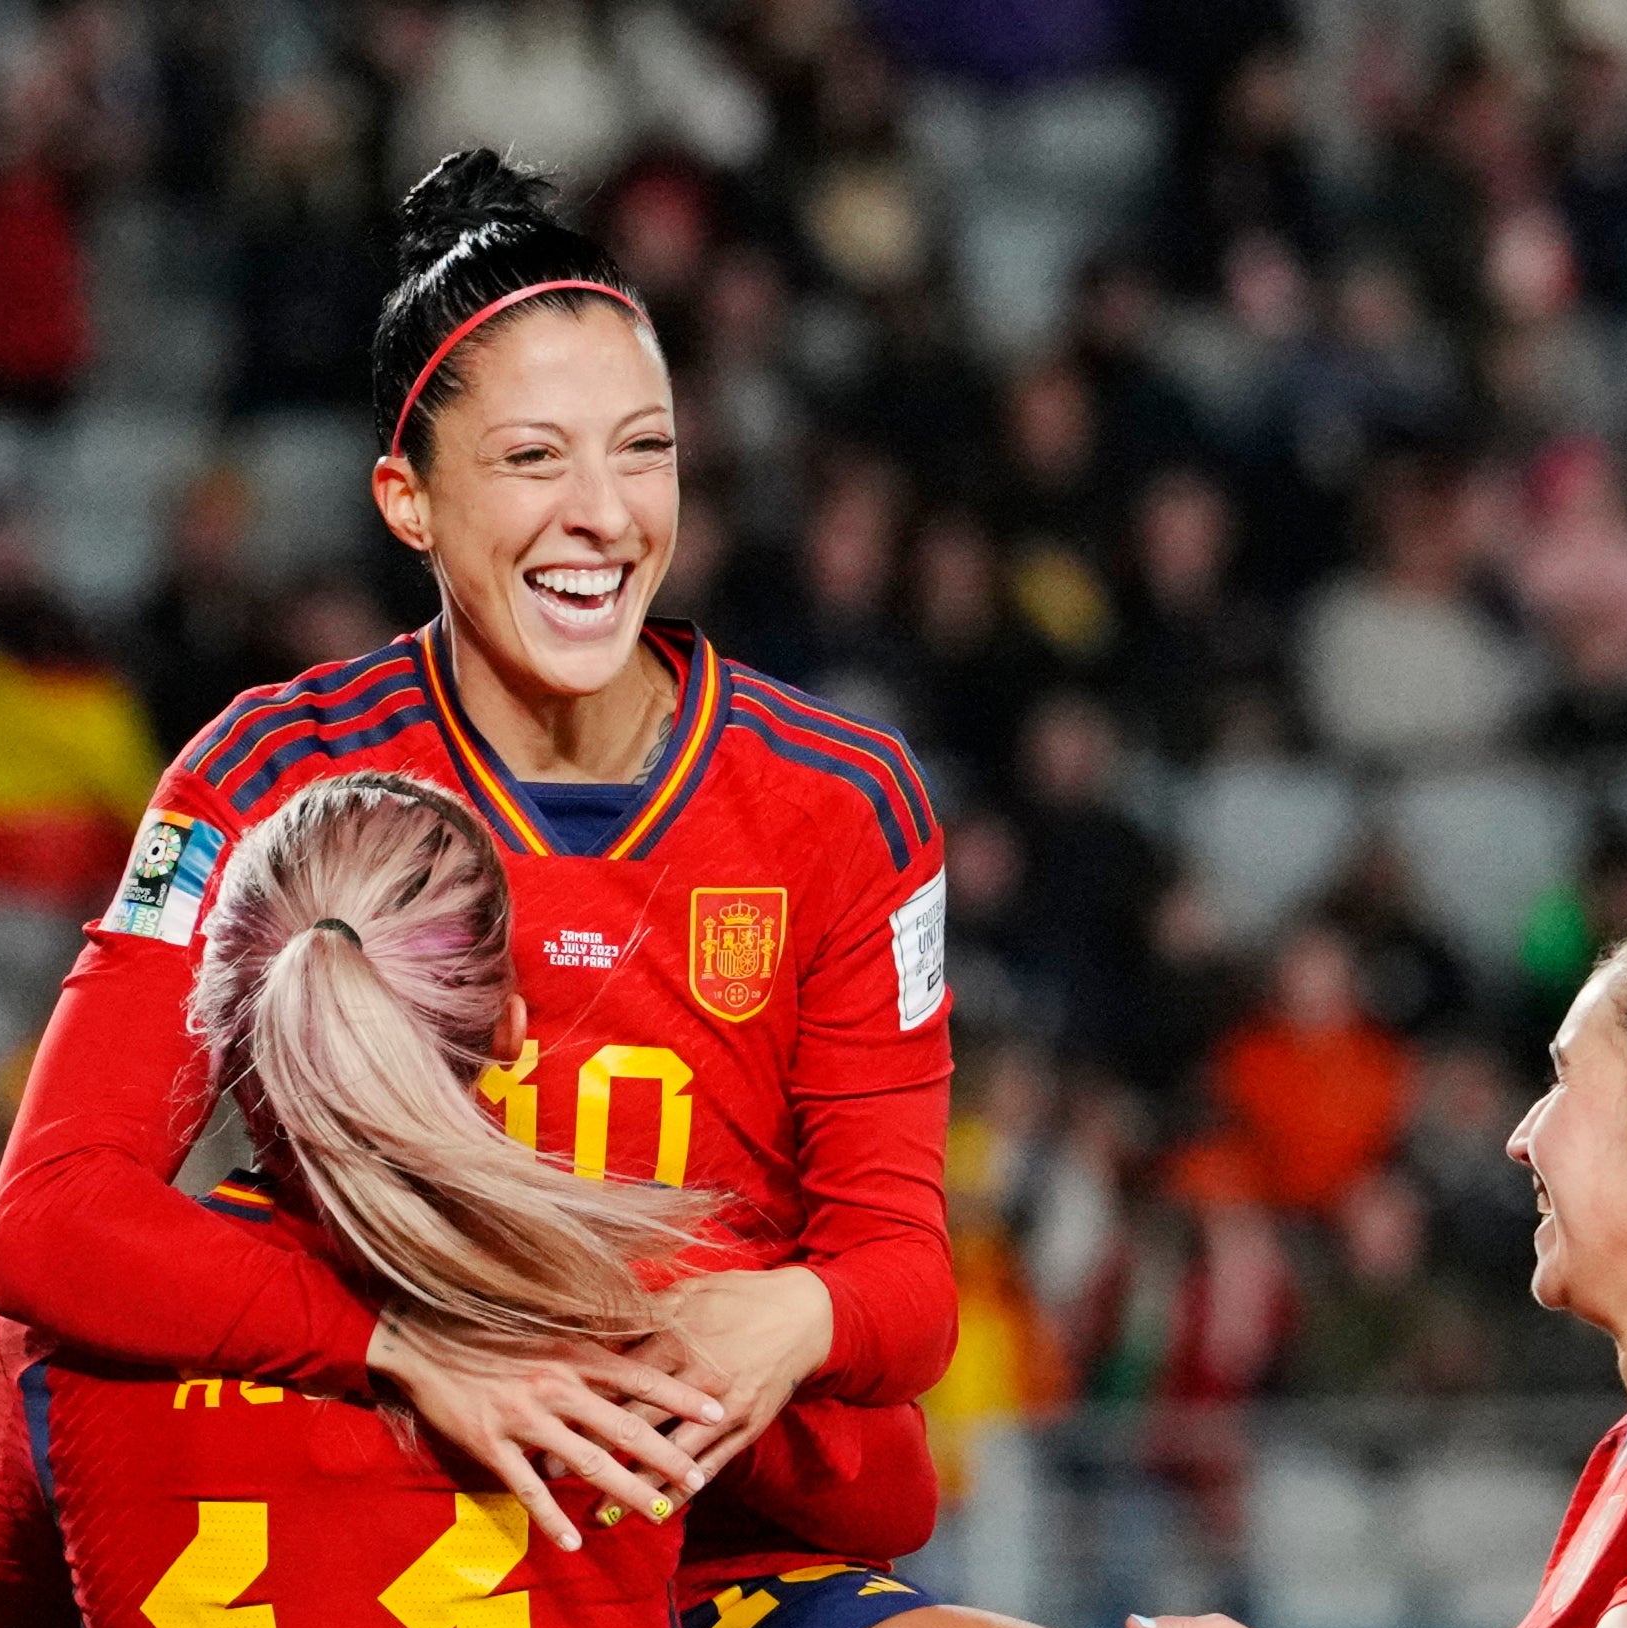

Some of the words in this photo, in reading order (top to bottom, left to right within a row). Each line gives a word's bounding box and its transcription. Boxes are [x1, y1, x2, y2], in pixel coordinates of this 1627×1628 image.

[559, 930, 603, 944] ZAMBIA
[543, 941, 558, 953] 26
[560, 942, 588, 955] JULY
[589, 944, 619, 957] 2023
[549, 953, 580, 967] EDEN
[582, 956, 612, 969] PARK
[477, 1039, 694, 1190] 10
